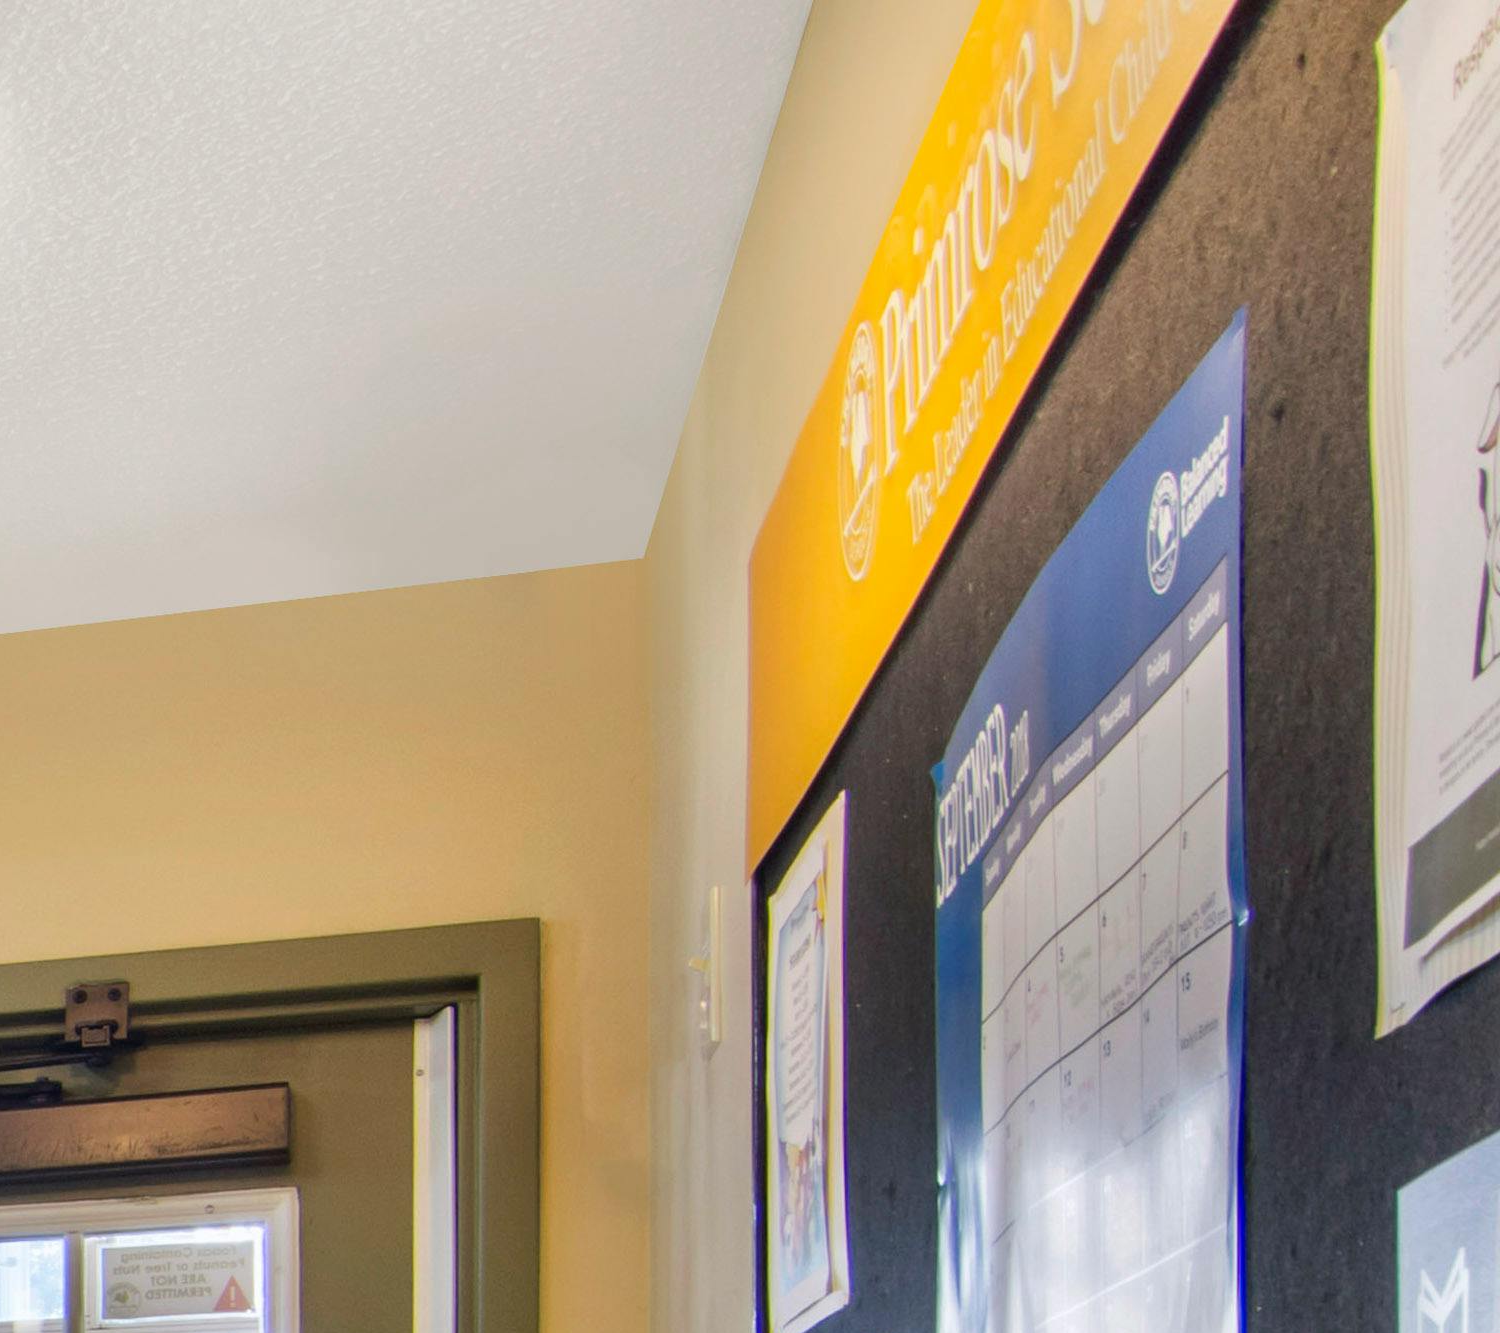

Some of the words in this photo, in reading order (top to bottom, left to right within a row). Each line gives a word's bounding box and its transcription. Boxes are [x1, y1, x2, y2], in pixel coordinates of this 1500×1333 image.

[879, 32, 1037, 476] Primrose
[906, 470, 936, 544] The
[932, 367, 986, 498] Leader
[982, 328, 1001, 399] in
[999, 107, 1107, 360] Educational
[1180, 415, 1229, 507] Balanced
[1180, 454, 1228, 538] Learning
[1052, 734, 1094, 785] Wednesday
[1099, 694, 1131, 738] Thursday
[1146, 650, 1171, 687] Friday
[1188, 590, 1220, 642] Saturday
[935, 703, 1009, 908] SEPTEMBER
[1181, 971, 1192, 991] 15
